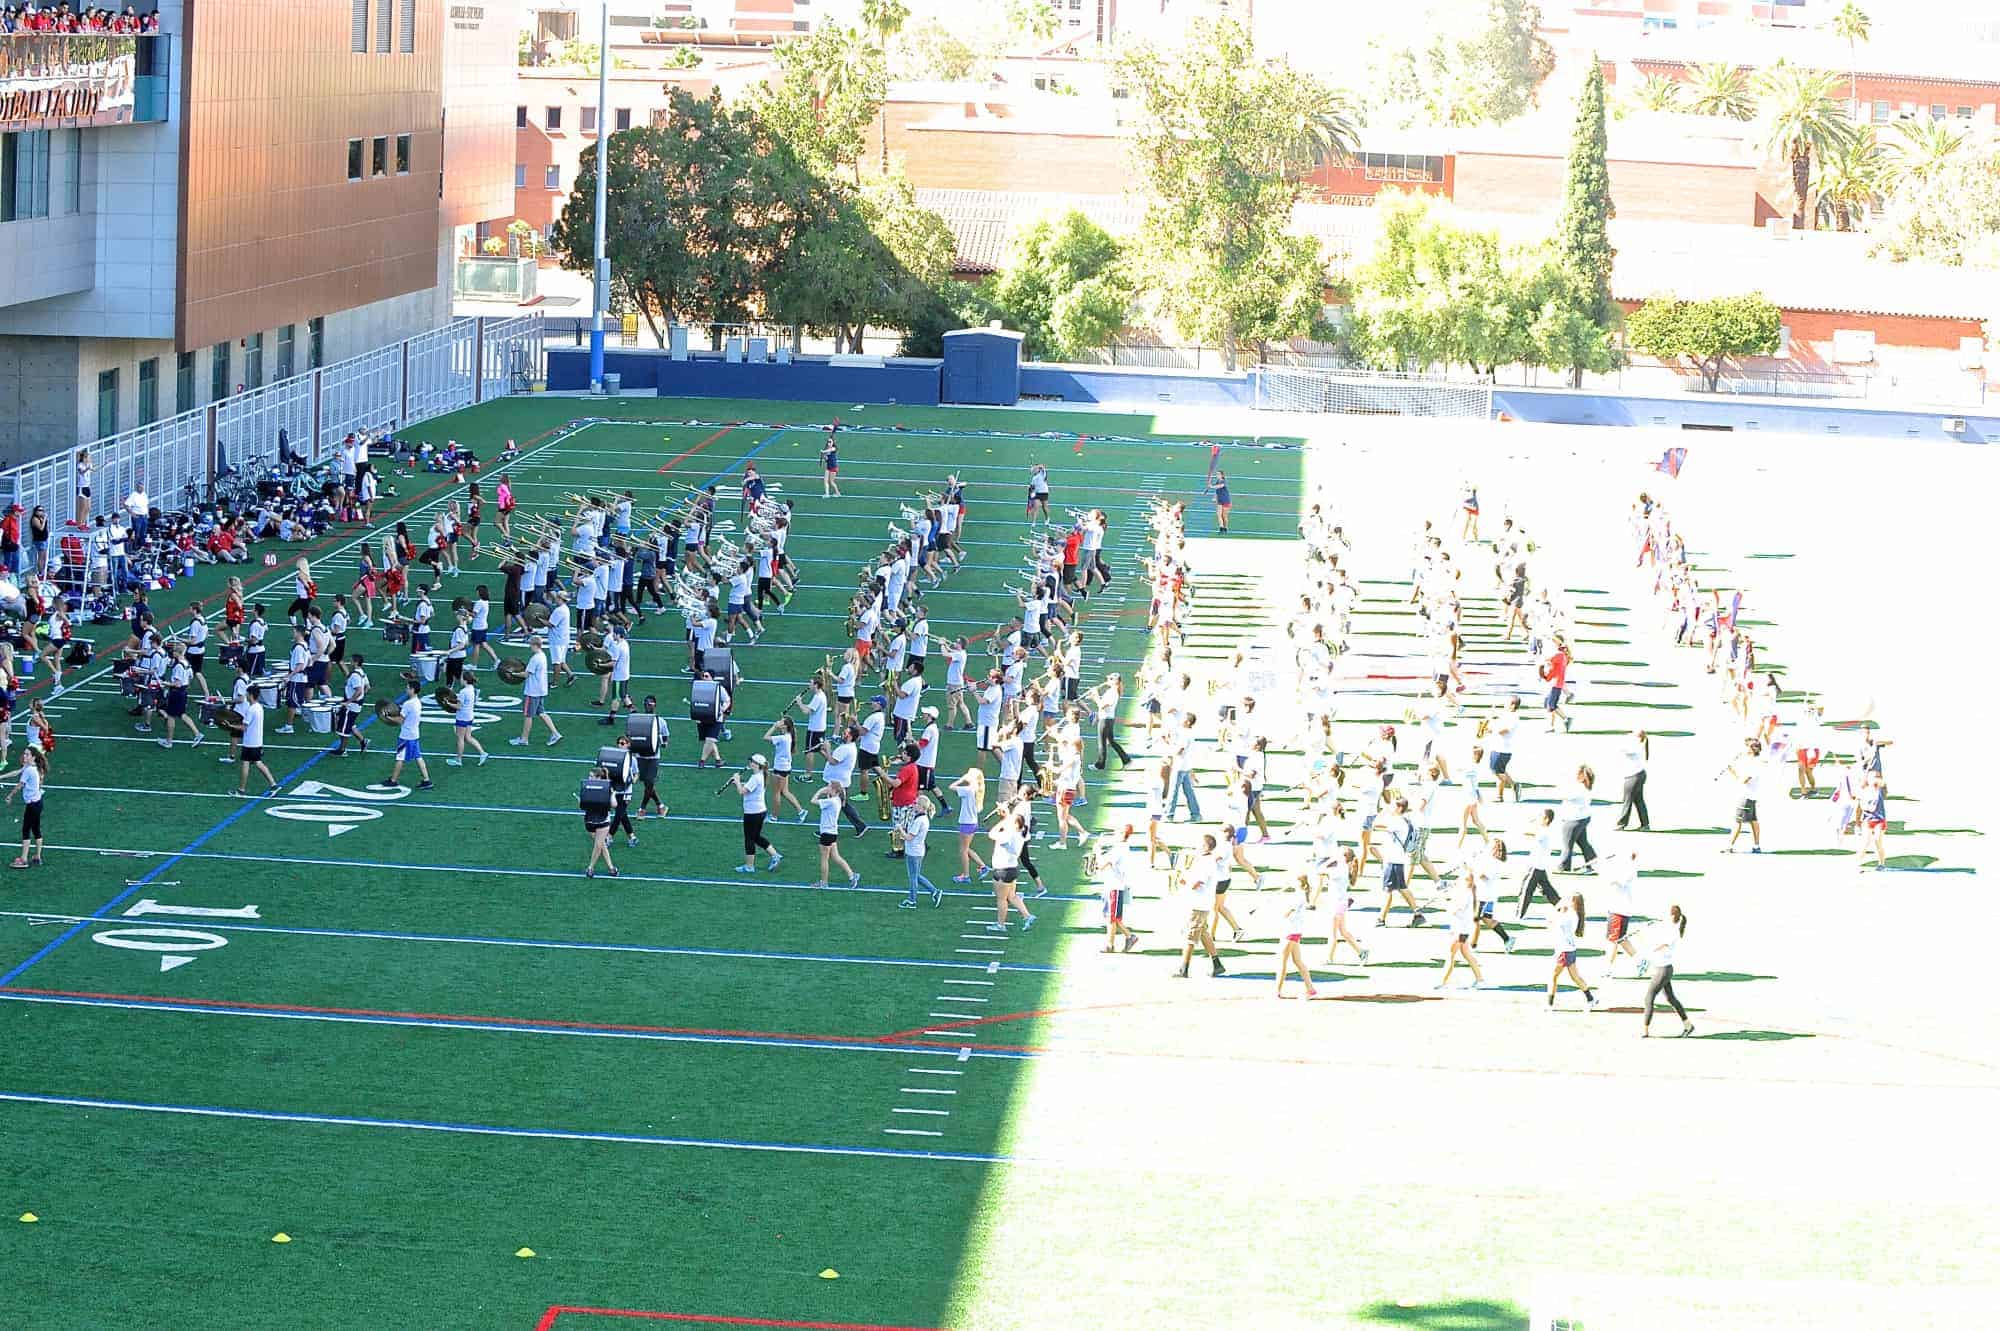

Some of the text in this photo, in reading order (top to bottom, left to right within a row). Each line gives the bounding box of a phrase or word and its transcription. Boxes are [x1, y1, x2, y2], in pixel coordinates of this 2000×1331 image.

[264, 553, 277, 566] 40
[264, 780, 412, 821] 20
[92, 899, 262, 951] 10
